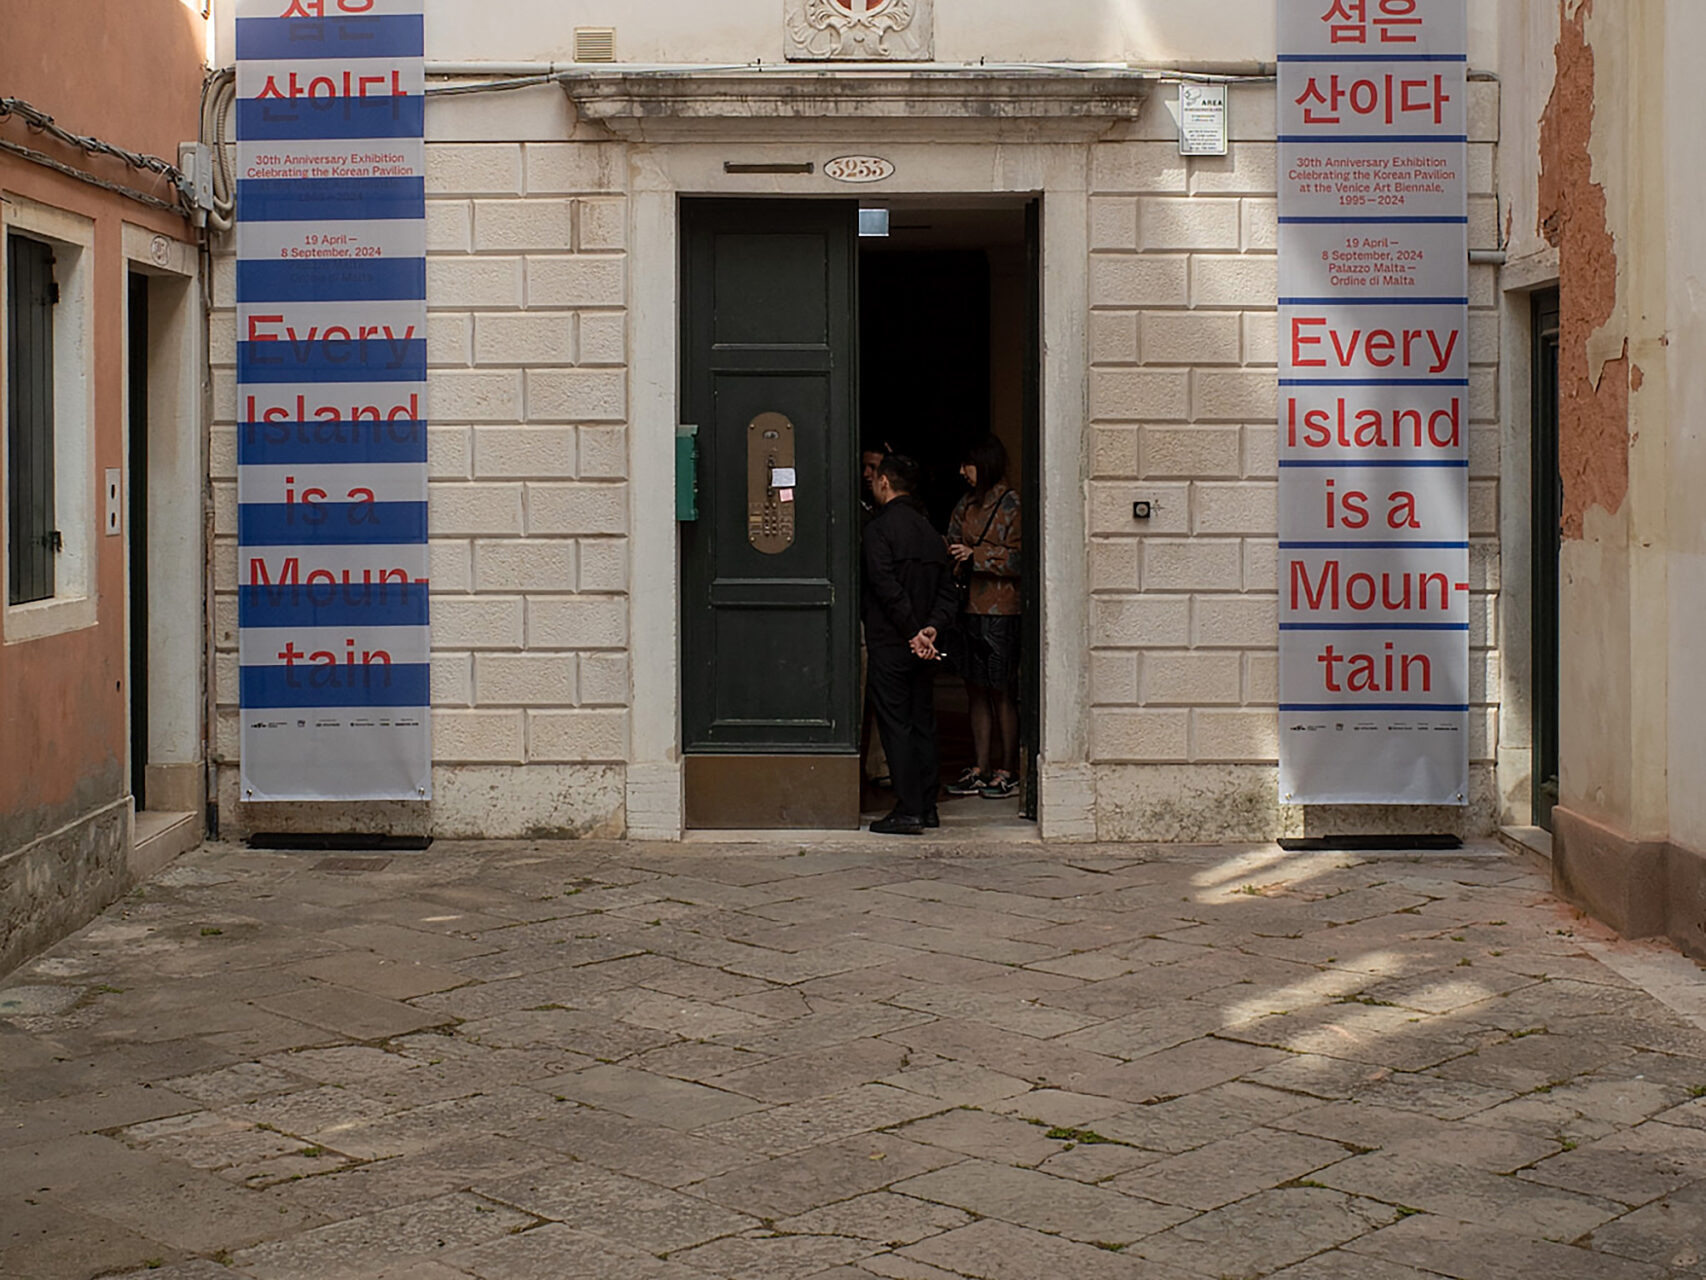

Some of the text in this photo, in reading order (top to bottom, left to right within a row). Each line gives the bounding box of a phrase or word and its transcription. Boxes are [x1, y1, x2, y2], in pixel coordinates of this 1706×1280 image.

[255, 70, 408, 123] 산이다
[1295, 73, 1450, 125] 산이다
[256, 153, 405, 166] 30th Anniversary Exhibition
[832, 159, 885, 177] 3253
[1296, 156, 1447, 169] 30th Anniversary Exhibition
[247, 165, 413, 178] Celebrating the Korean Pavilion
[1288, 169, 1455, 182] Celebrating the Korean Pavilion
[1299, 183, 1311, 193] at
[1314, 183, 1332, 193] the
[1335, 182, 1371, 193] Venice
[1373, 182, 1391, 193] Art
[304, 234, 319, 246] 19
[1345, 238, 1359, 248] 19
[280, 246, 382, 258] 8 September, 2024
[1321, 250, 1424, 261] 8 September, 2024
[1328, 263, 1371, 273] Palazzo
[1330, 275, 1415, 286] Ordine di Malta
[247, 315, 416, 371] Every
[1291, 317, 1459, 373] Every
[246, 393, 420, 445] Island
[1287, 397, 1460, 448] Island
[285, 476, 380, 526] is a
[1325, 479, 1421, 529] is a
[1290, 560, 1469, 611] Moun-
[277, 638, 393, 689] tain
[1317, 642, 1431, 693] tain
